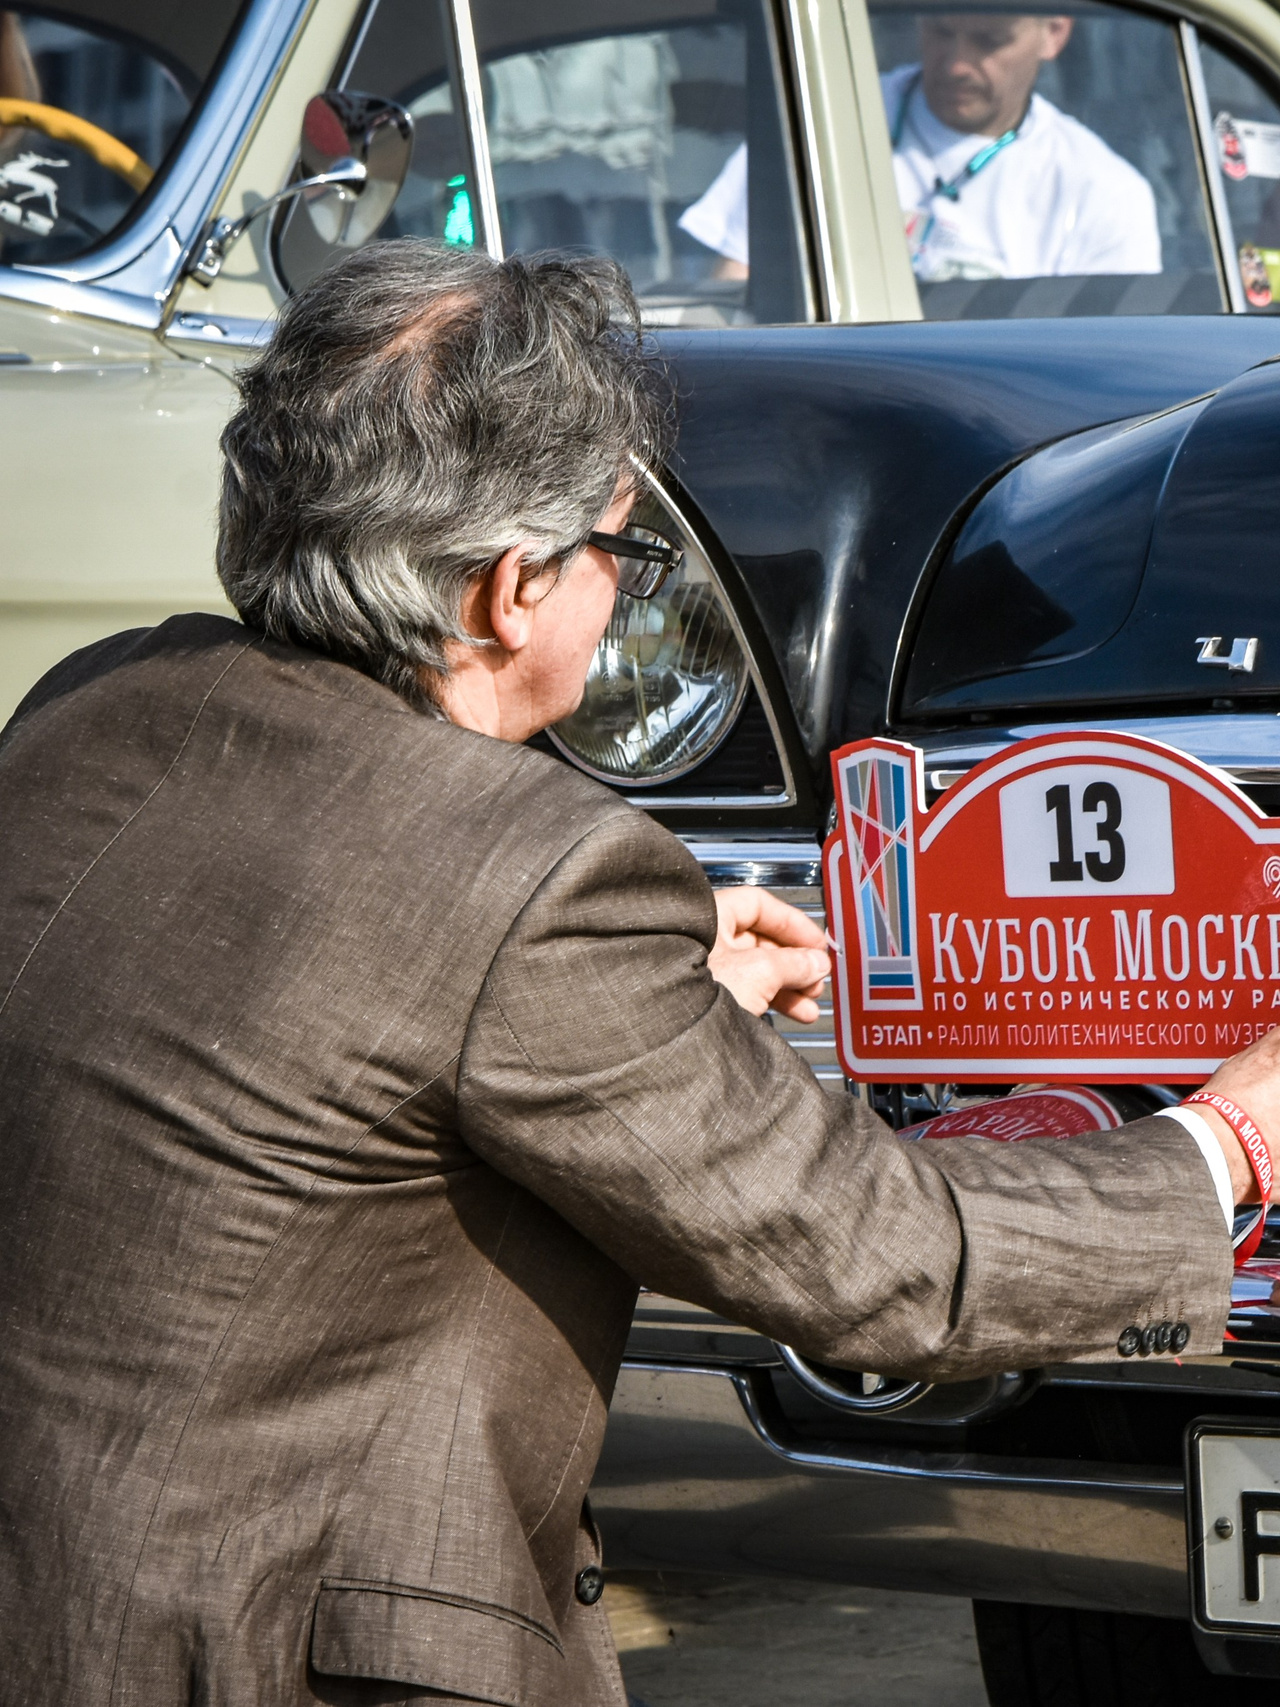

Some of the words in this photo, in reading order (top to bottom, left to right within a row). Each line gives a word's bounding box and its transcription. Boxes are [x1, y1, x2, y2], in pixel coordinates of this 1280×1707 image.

[1045, 781, 1126, 882] 13
[933, 991, 967, 1012] ПО
[984, 988, 1234, 1012] ИСТОРИЧЕСКОМУ
[871, 1024, 922, 1046] ЭТАП
[938, 1024, 1000, 1046] РАЛЛИ
[1006, 1023, 1207, 1046] ПОЛИТЕХНИЧЕСКОГО
[1238, 1119, 1274, 1195] МОСКВЫ
